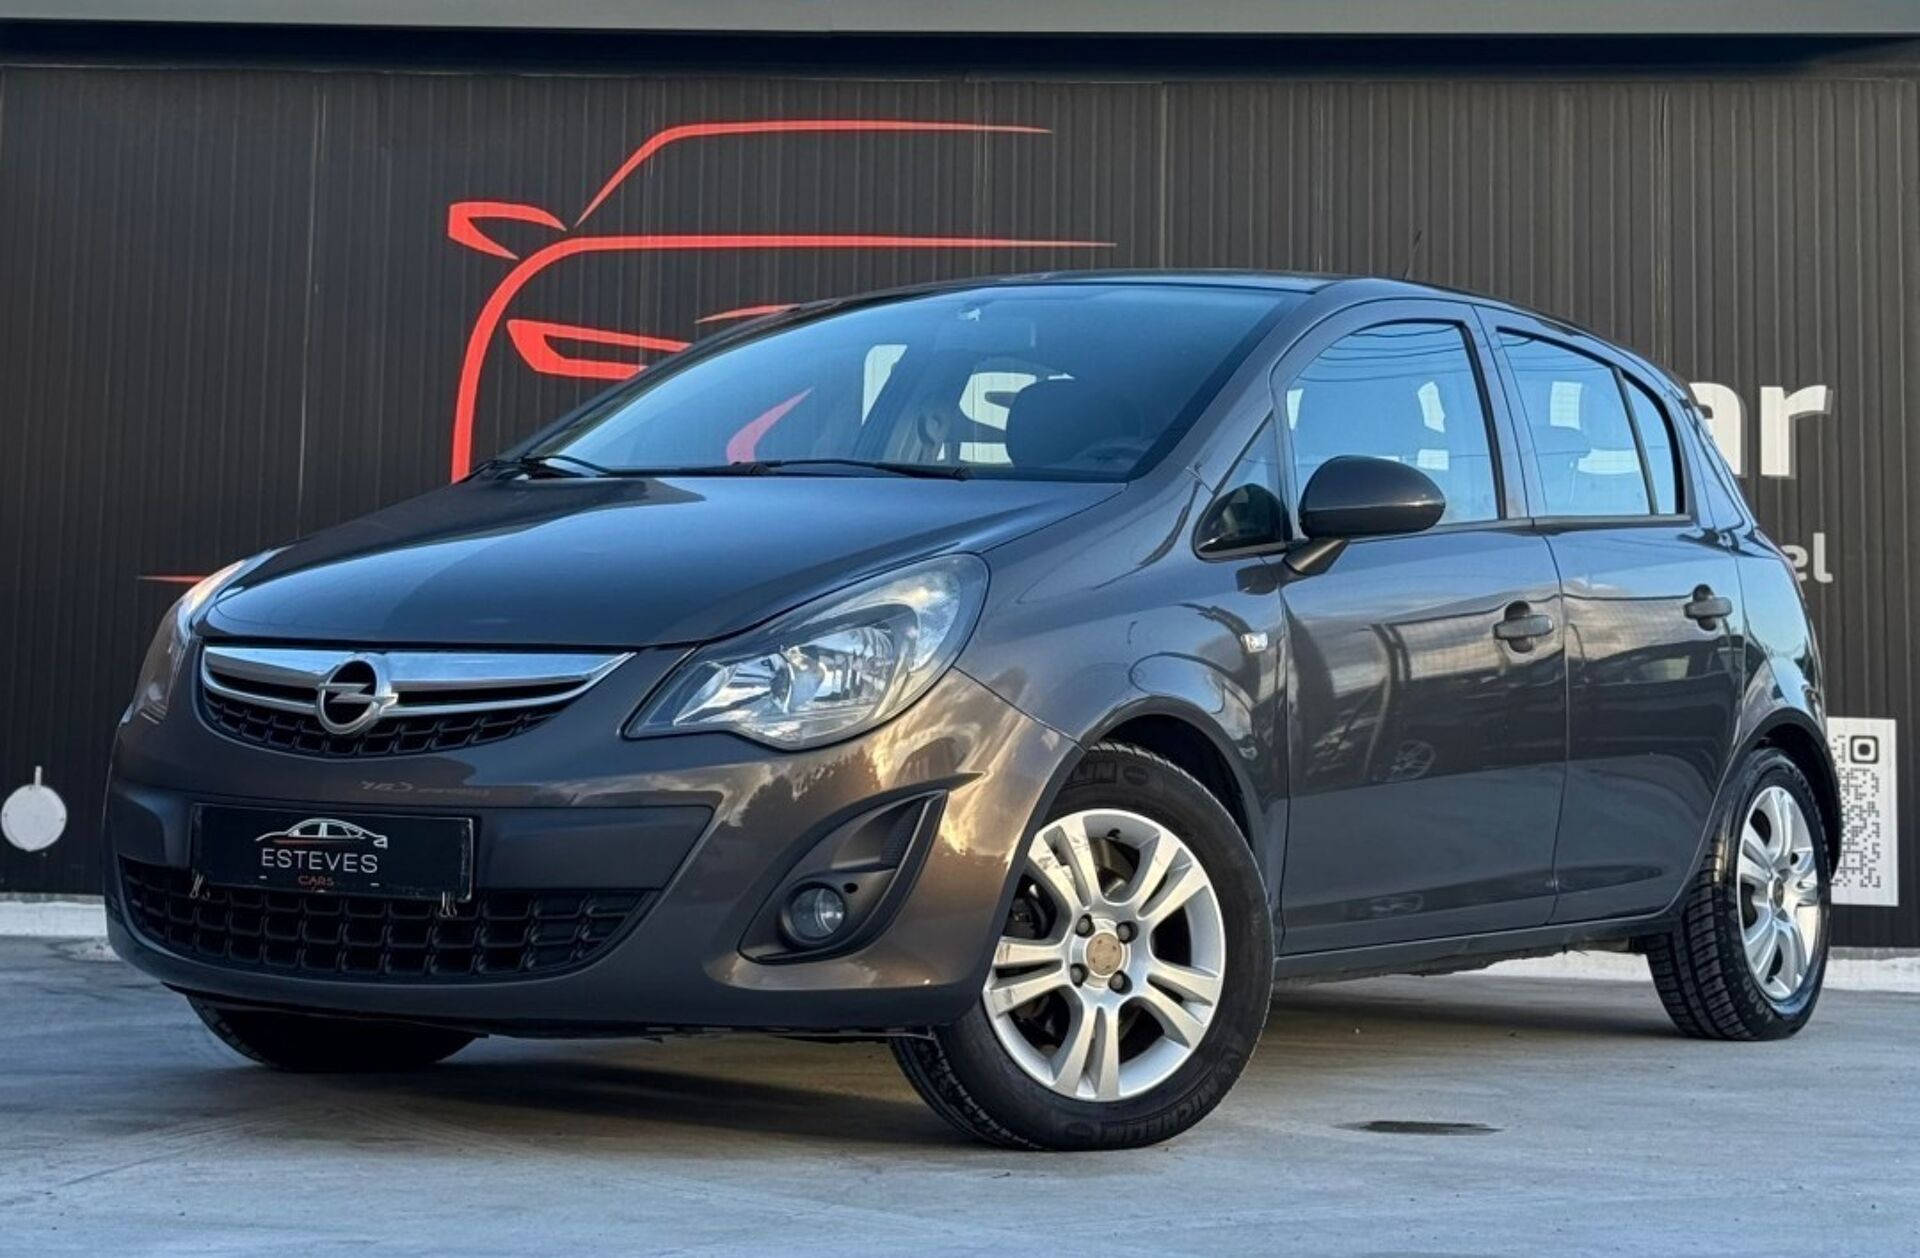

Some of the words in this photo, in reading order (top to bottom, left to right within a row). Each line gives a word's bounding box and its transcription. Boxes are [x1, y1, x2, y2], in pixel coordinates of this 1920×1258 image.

[1781, 532, 1833, 584] el
[261, 848, 378, 874] ESTEVES
[298, 875, 335, 887] CARS
